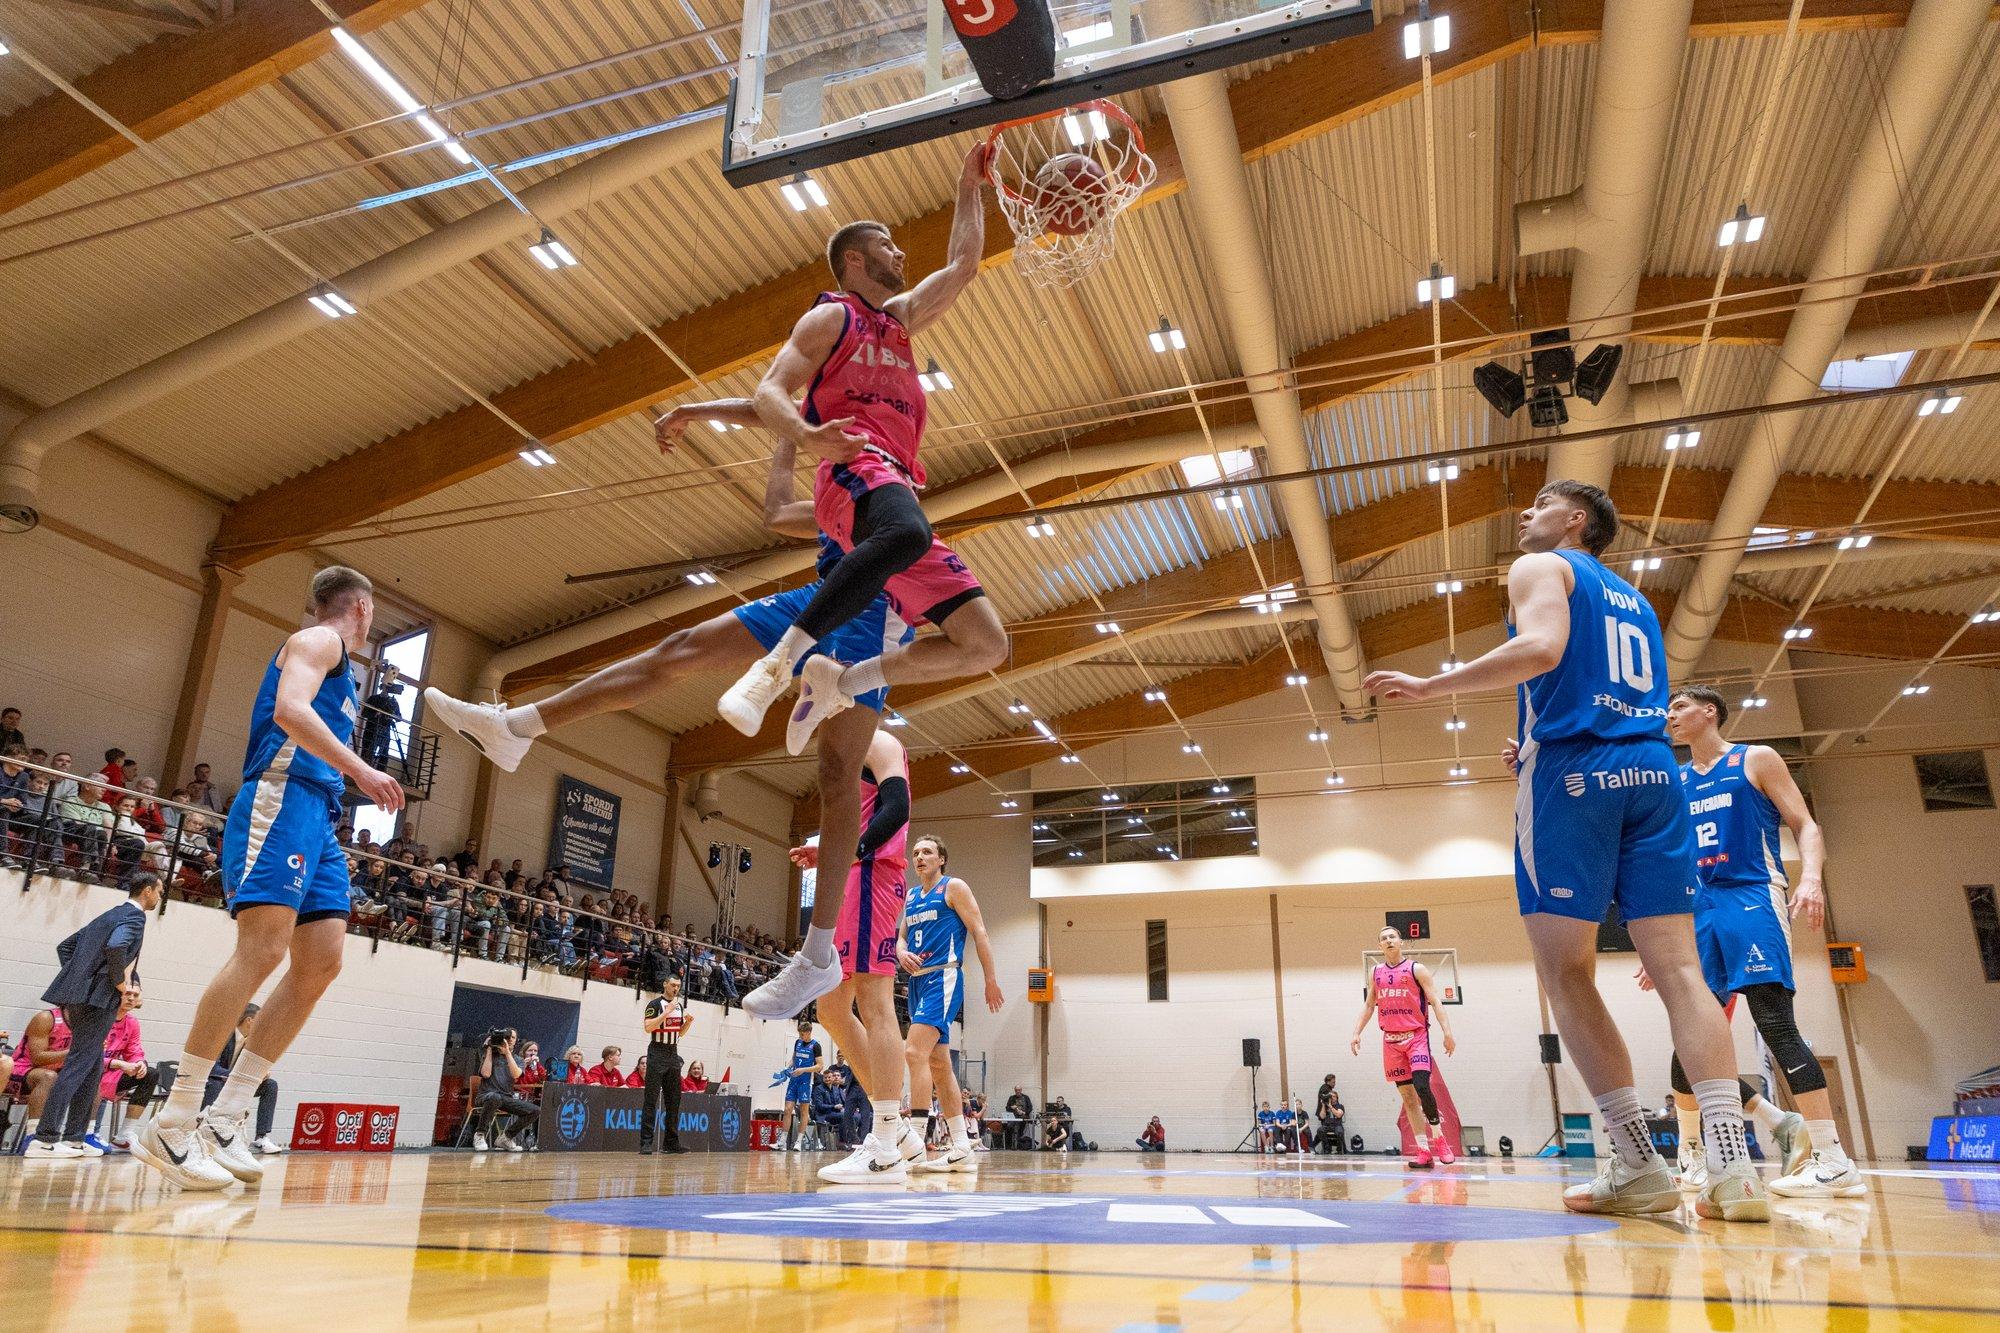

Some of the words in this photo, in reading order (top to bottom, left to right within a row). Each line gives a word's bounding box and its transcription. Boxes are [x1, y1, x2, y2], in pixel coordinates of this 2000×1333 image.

[1604, 615, 1654, 693] 10
[1592, 693, 1668, 718] HONDA
[1592, 767, 1669, 789] Tallinn
[582, 803, 613, 820] AREENID
[583, 793, 615, 812] SPORDI
[1695, 821, 1719, 848] 12
[914, 929, 923, 948] 9
[1388, 974, 1394, 985] 3
[336, 1110, 364, 1130] Opti
[371, 1111, 396, 1130] Opti
[1963, 1119, 1988, 1138] Linus
[336, 1127, 357, 1144] bet
[371, 1128, 390, 1145] bet
[1960, 1139, 1996, 1159] Medical
